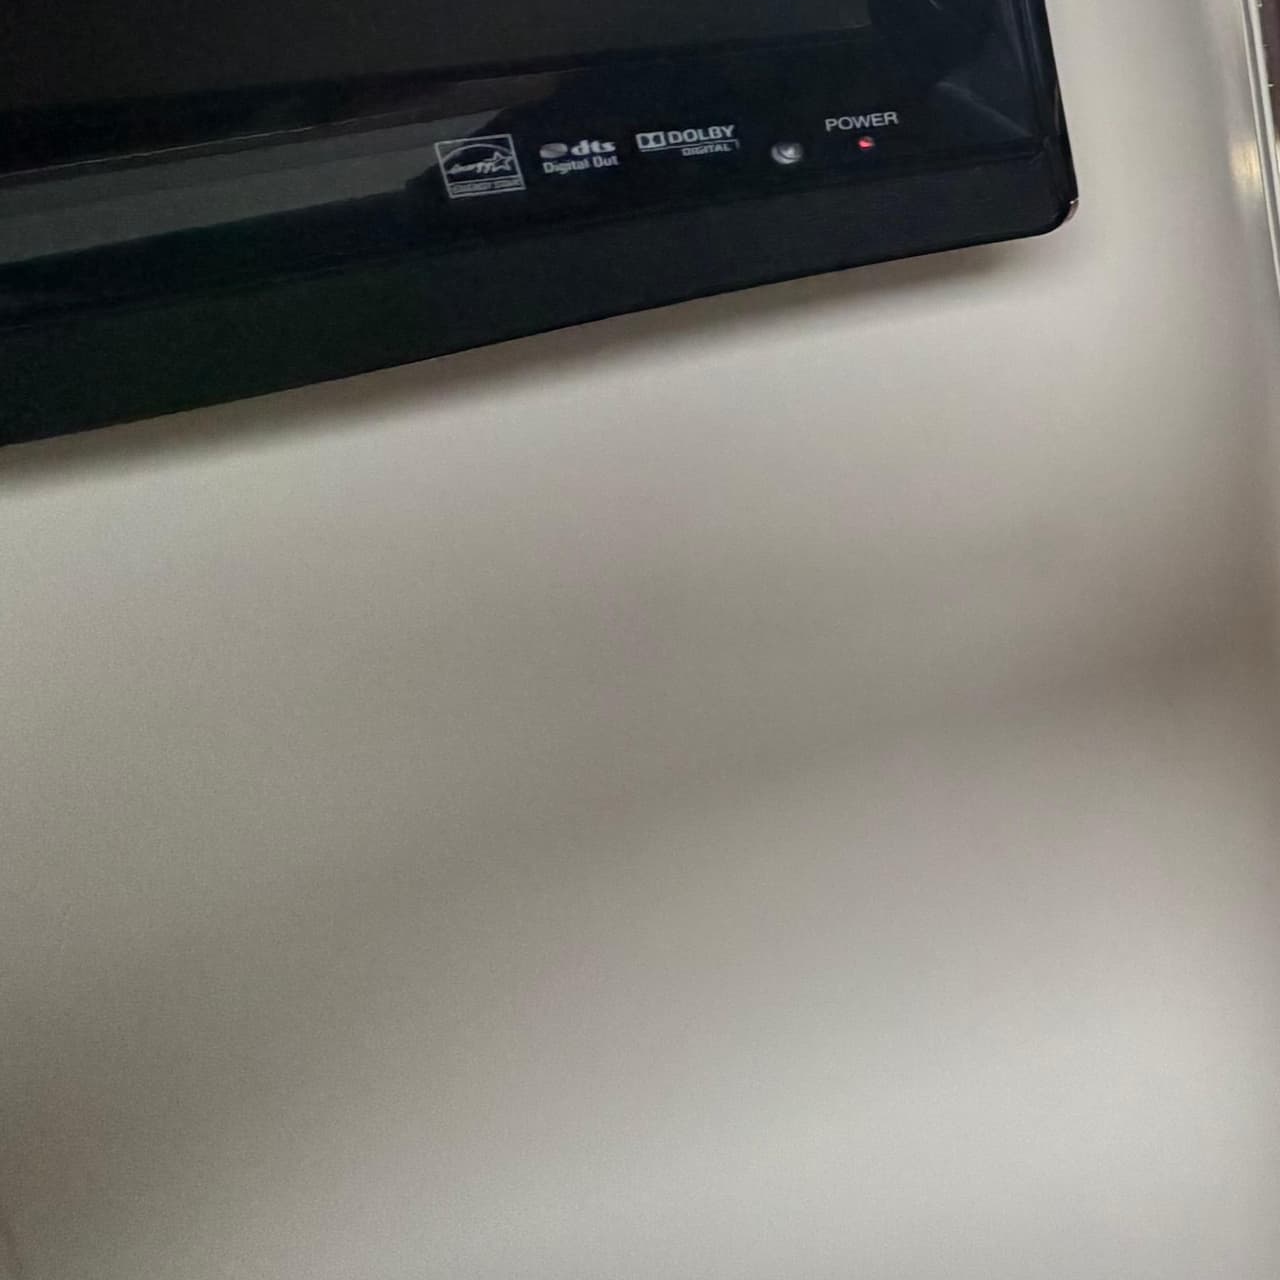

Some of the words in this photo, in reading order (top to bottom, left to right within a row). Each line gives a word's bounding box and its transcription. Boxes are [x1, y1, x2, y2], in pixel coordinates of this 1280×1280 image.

[825, 112, 898, 131] POWER
[668, 125, 734, 144] DOLBY
[571, 140, 616, 155] dts
[681, 144, 732, 156] DIGITAL
[542, 160, 590, 174] Digital
[593, 155, 619, 168] Out
